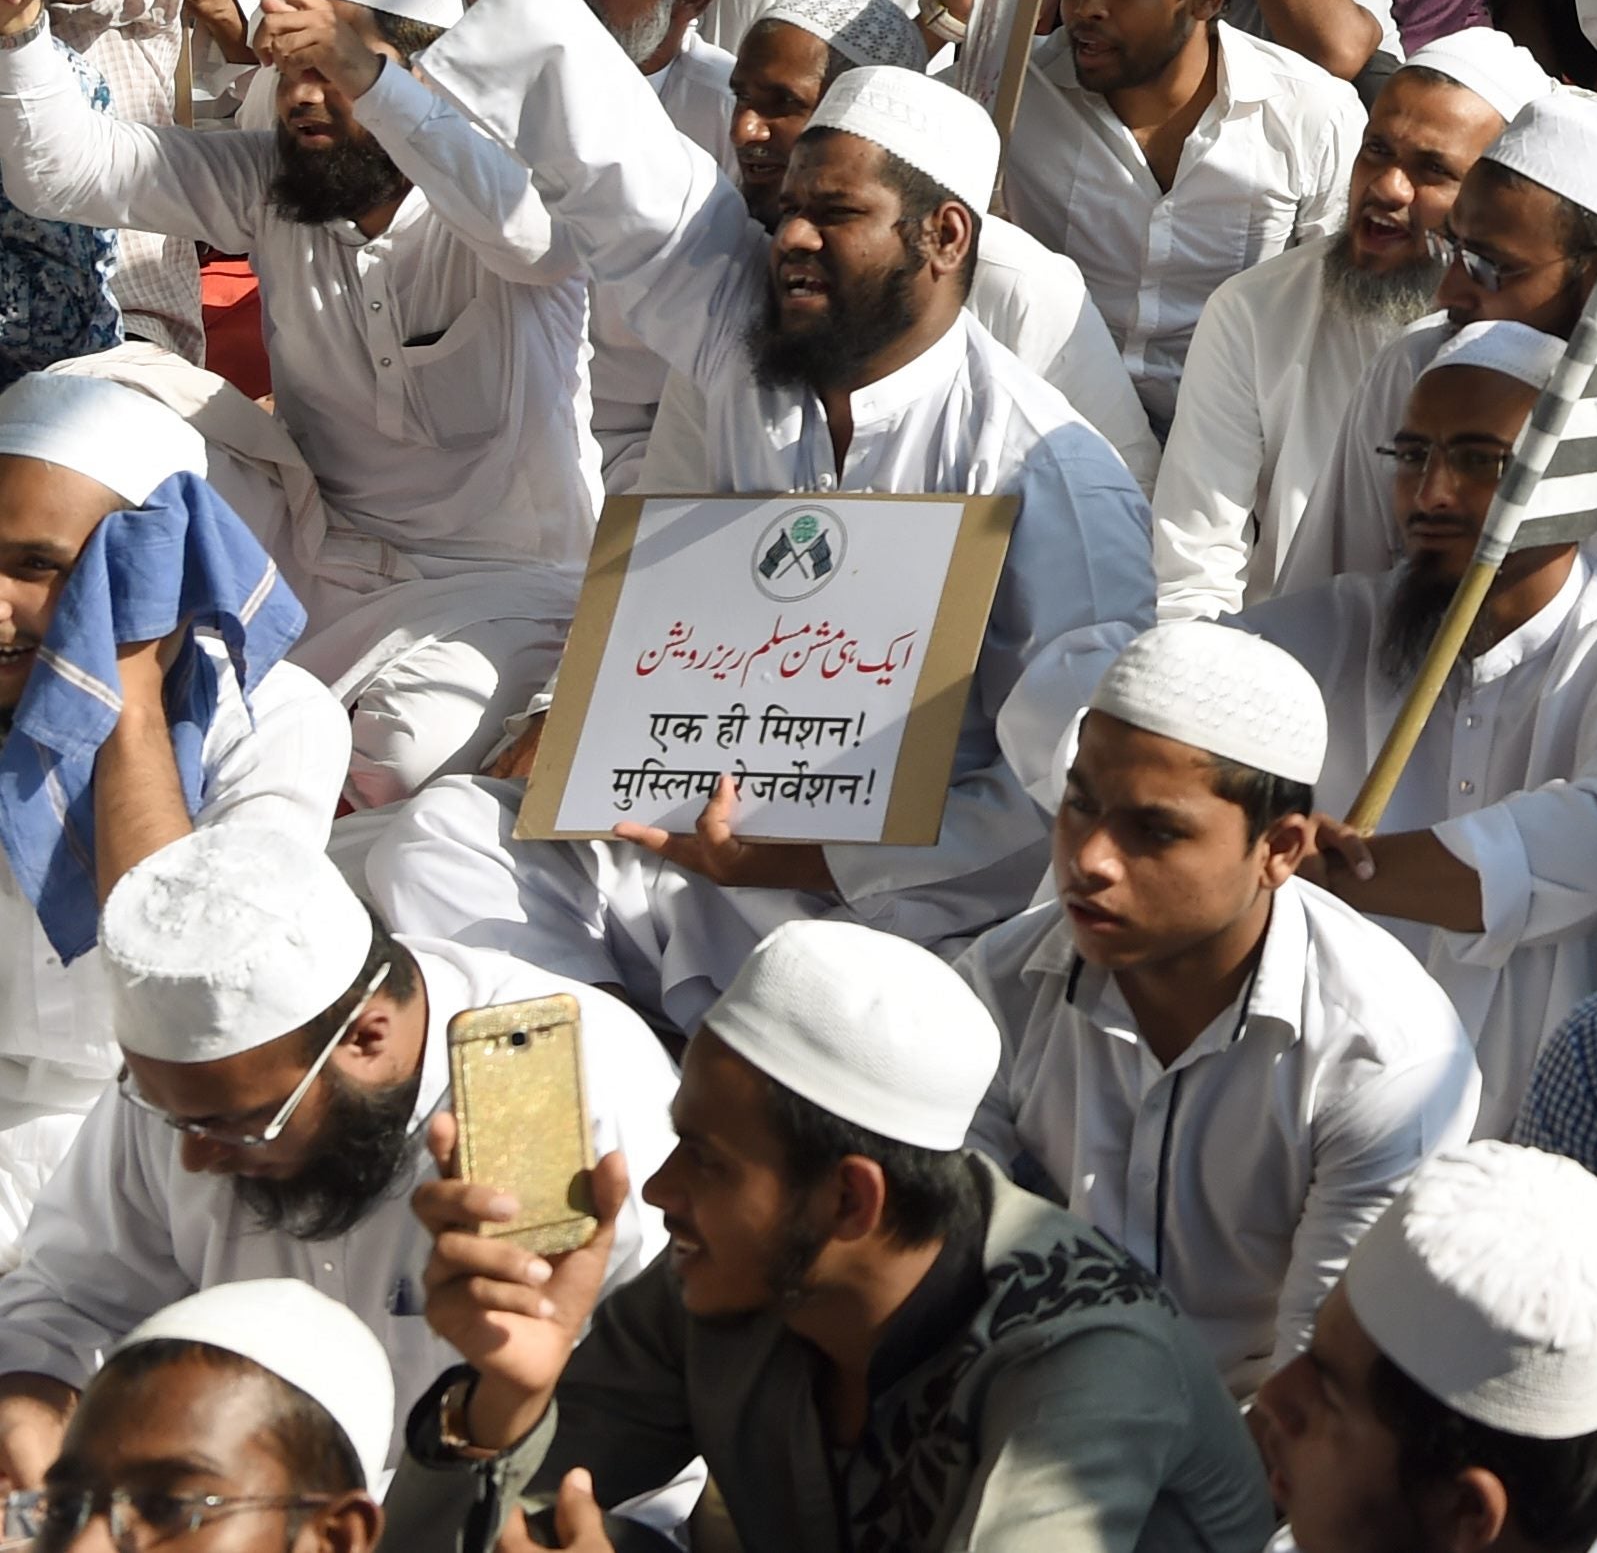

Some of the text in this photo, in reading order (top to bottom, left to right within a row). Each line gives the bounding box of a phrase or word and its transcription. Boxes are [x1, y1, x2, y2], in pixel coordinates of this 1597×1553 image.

[636, 615, 918, 688] ایک ہی مشن مسلم ریزرویشن
[650, 702, 866, 753] एक ही मिशन!
[613, 758, 876, 811] मुस्लिम रेजर्वेशन!
